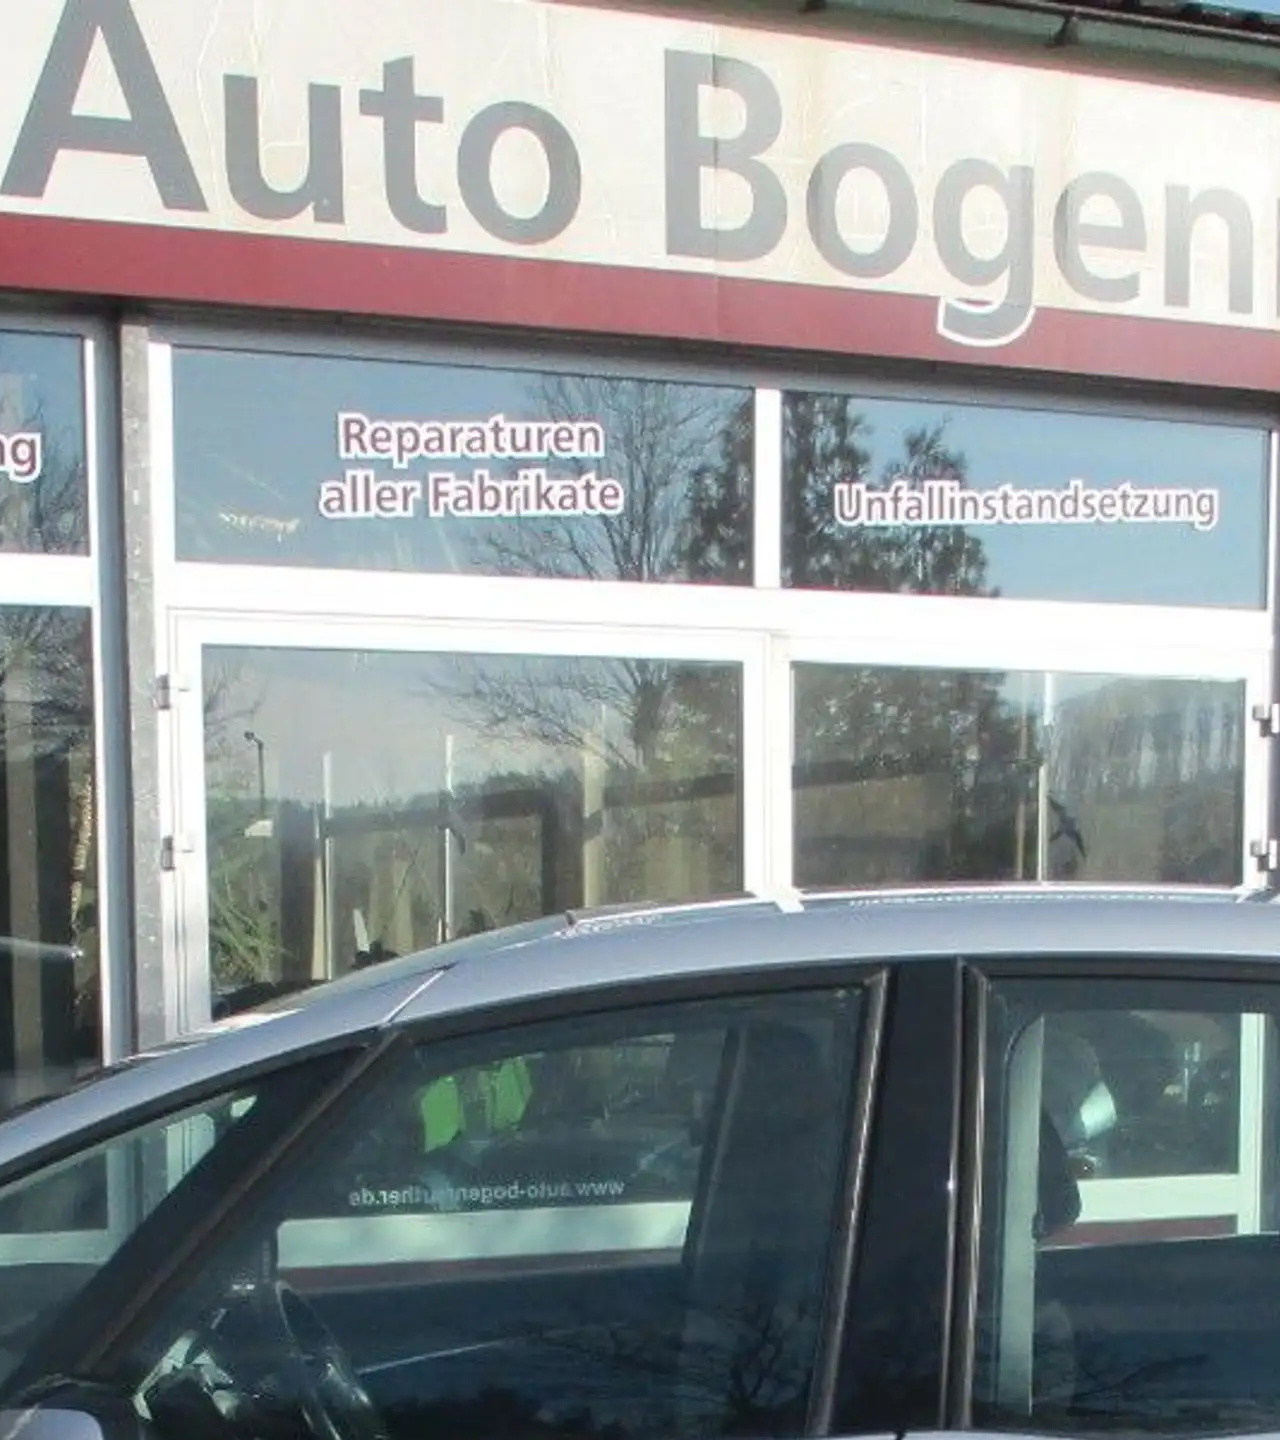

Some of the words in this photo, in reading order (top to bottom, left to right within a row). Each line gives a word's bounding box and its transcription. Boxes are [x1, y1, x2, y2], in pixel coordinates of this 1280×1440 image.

[336, 413, 605, 469] Reparaturen
[319, 472, 421, 519] aller
[426, 468, 625, 518] Fabrikate
[834, 480, 1220, 532] Unfallinstandsetzung
